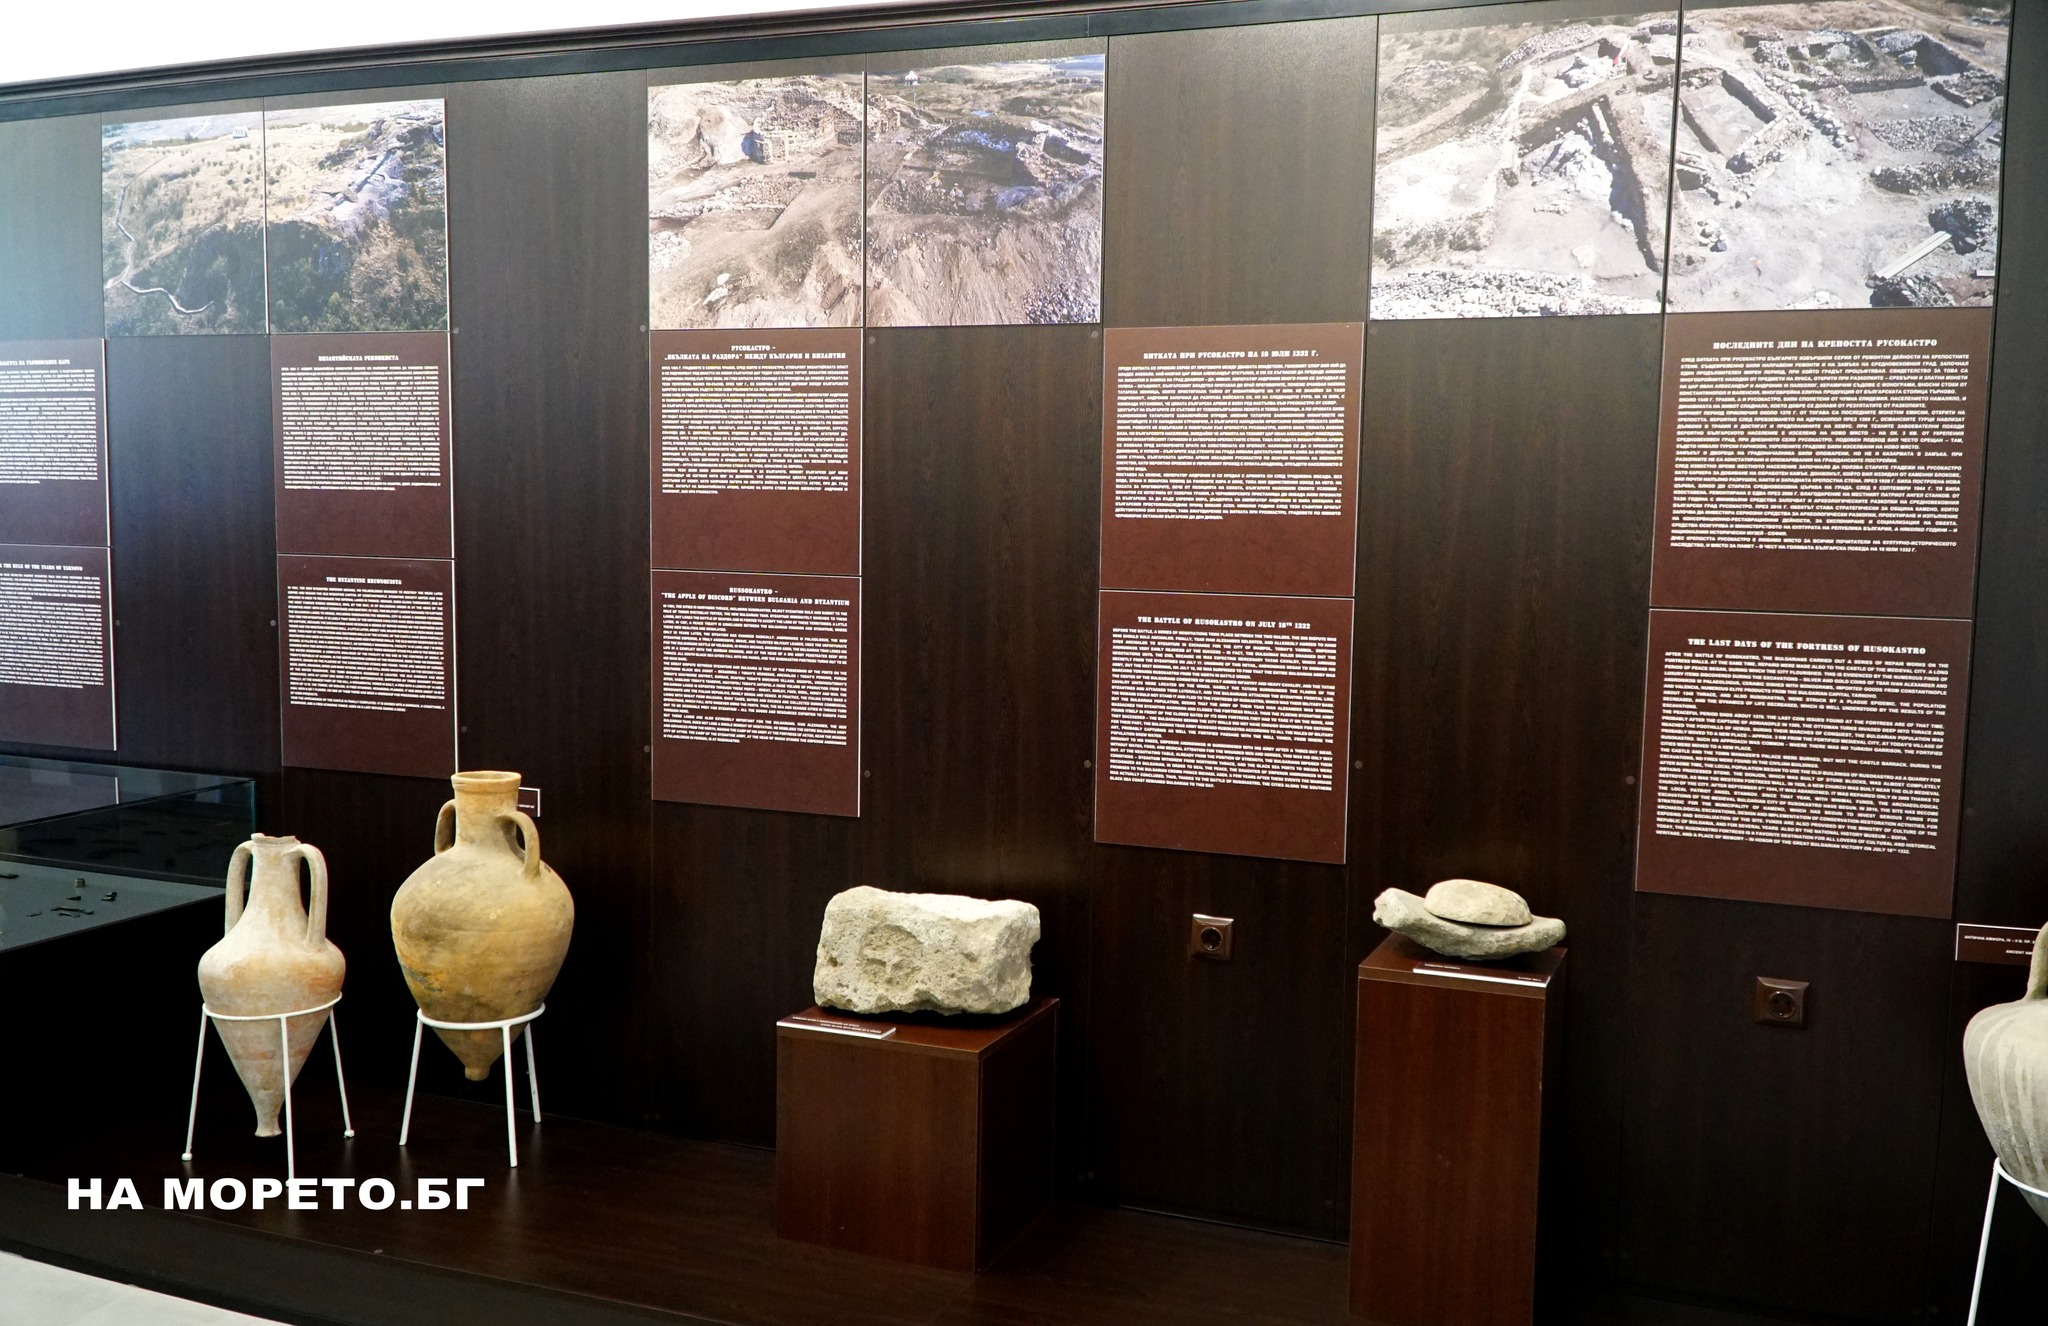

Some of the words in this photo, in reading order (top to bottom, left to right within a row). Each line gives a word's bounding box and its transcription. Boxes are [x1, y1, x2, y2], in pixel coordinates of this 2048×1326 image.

[1712, 341, 1774, 350] ПОСЛЕДНИТЕ
[1777, 340, 1797, 348] ДНИ
[1817, 339, 1872, 347] КРЕПОСТТА
[1876, 338, 1937, 347] РУСОКАСТРО
[1194, 618, 1242, 626] RUSOKASTRO
[1796, 642, 1844, 651] FORTRESS
[1863, 645, 1926, 654] RUSOKASTRO
